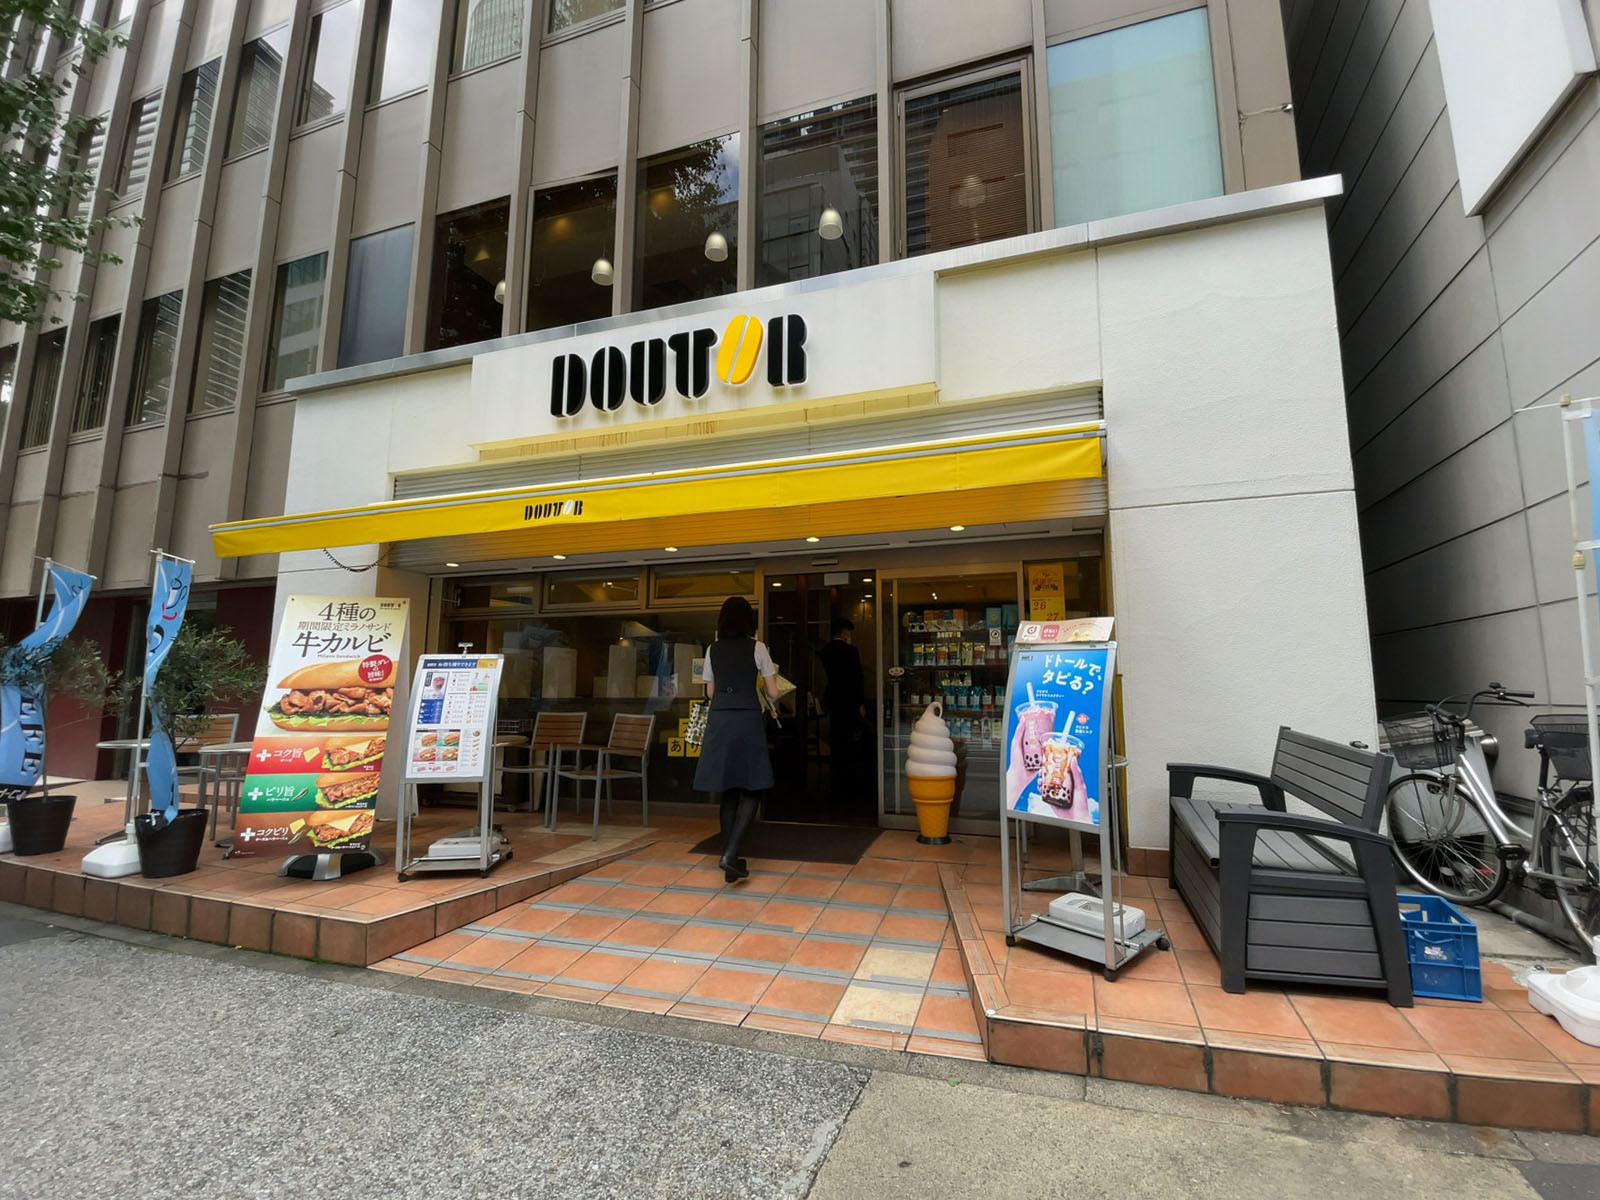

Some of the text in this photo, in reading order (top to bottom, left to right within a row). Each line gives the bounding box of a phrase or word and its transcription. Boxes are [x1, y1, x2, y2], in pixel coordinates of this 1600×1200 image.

[550, 313, 808, 418] DOUTOR
[524, 500, 583, 520] DOUTOR
[317, 602, 376, 622] 4種の
[297, 621, 392, 632] 期間限定ミラノサンド
[292, 632, 392, 658] 牛カルビ
